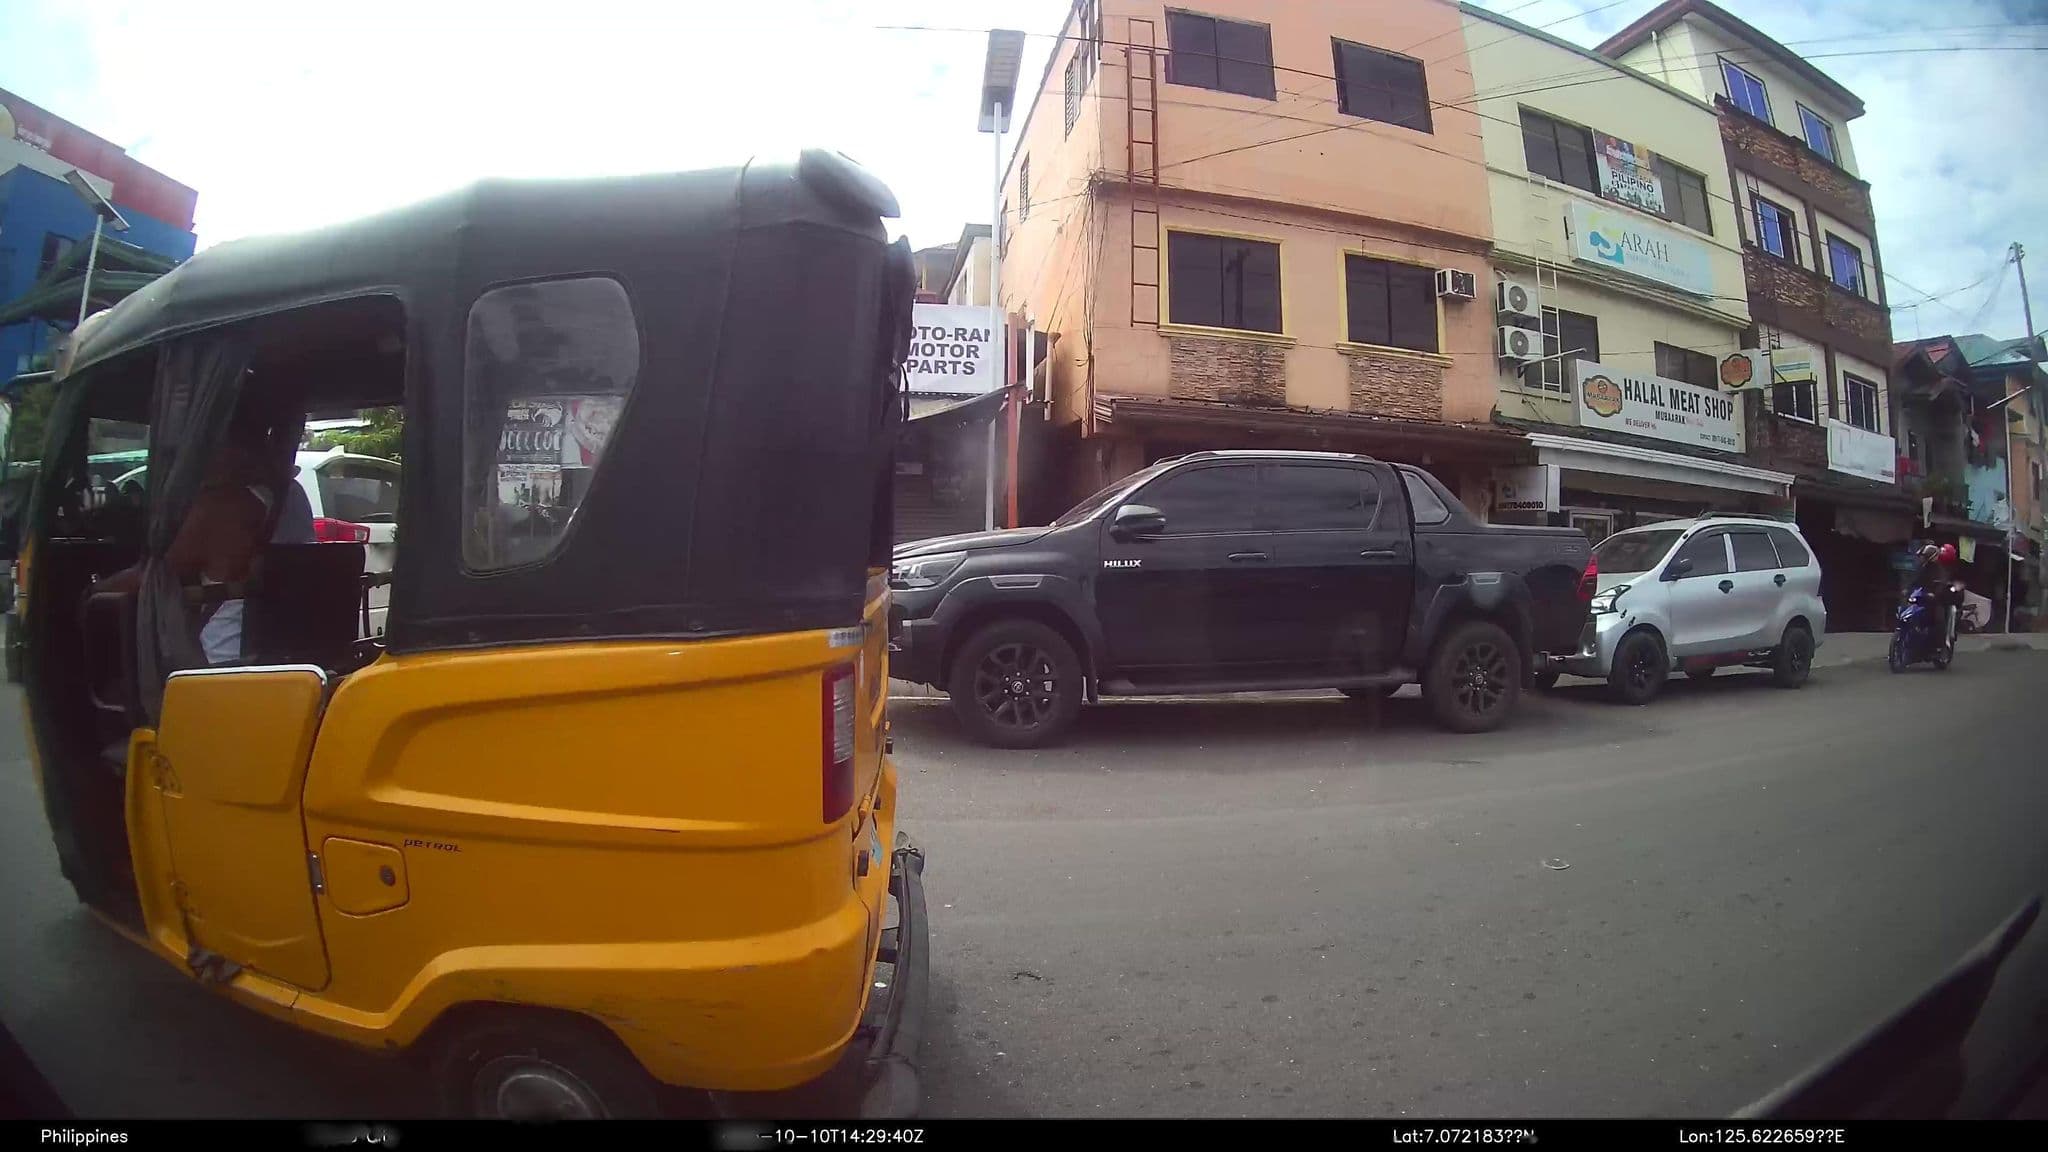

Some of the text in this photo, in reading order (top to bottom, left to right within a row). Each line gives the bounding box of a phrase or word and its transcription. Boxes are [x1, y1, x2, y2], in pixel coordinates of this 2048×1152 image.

[1611, 170, 1654, 193] PILIPINO
[906, 359, 976, 375] PARTS
[1623, 377, 1665, 407] HALAL
[1669, 387, 1701, 415] MEAT
[1704, 395, 1734, 421] SHOP
[1103, 559, 1142, 568] HILUX
[403, 839, 463, 853] PETROL
